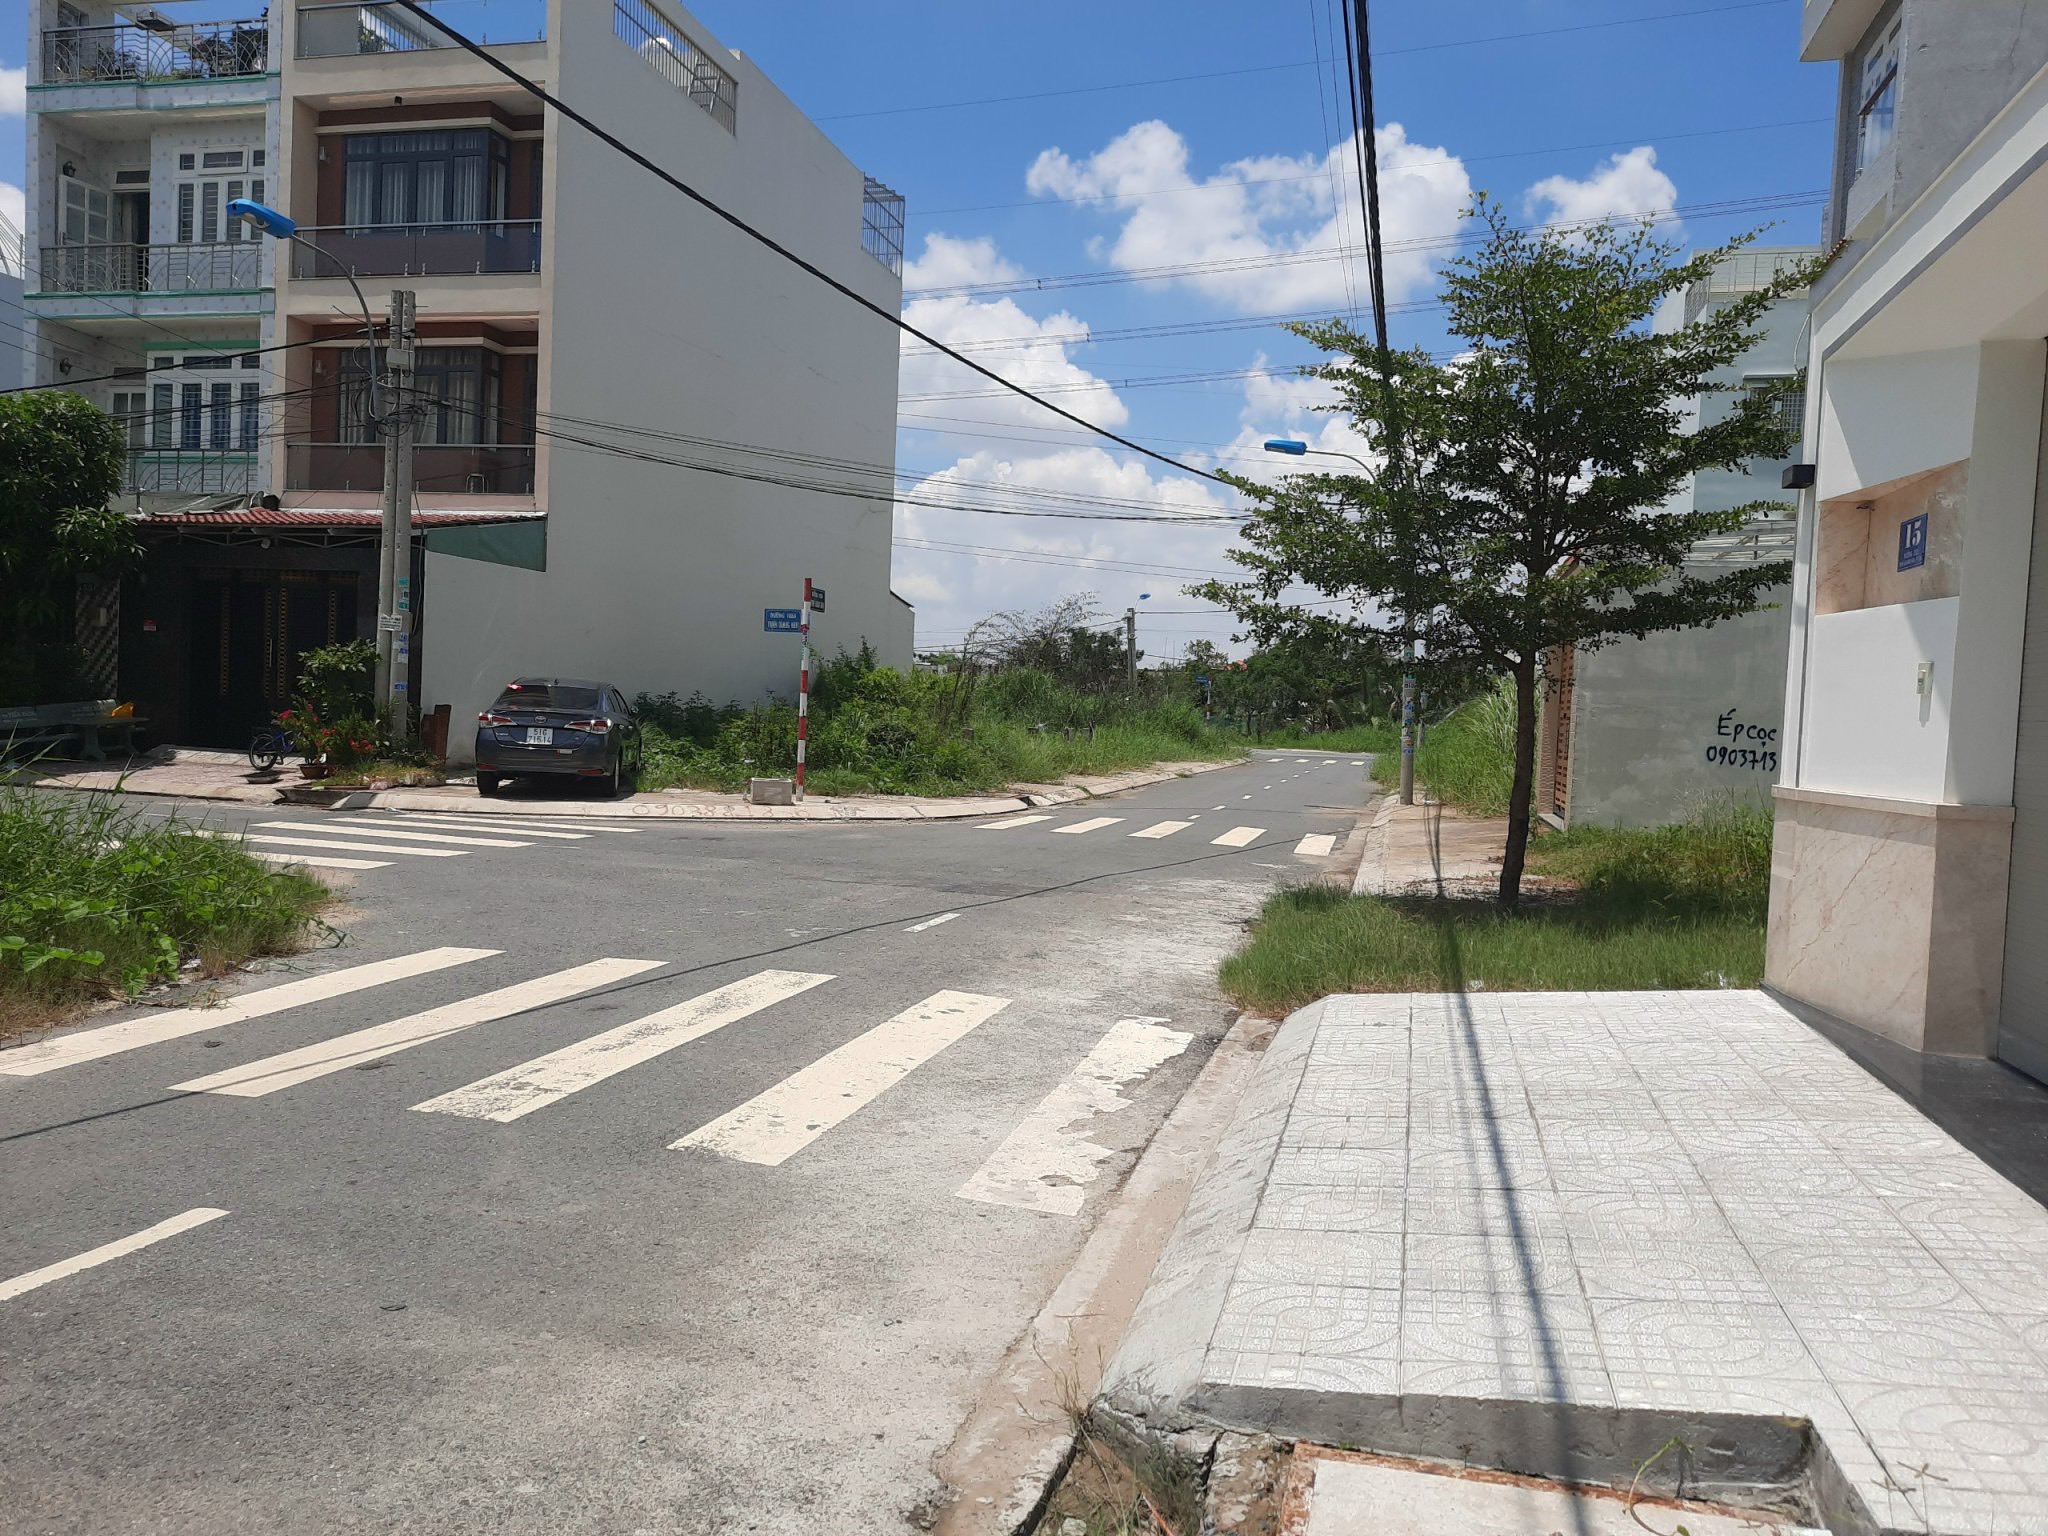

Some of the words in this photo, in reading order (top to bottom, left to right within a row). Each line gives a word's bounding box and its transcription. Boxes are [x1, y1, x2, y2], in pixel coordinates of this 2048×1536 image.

[1905, 520, 1922, 549] 15
[1717, 708, 1745, 743] Ép
[1746, 725, 1777, 748] cọc
[1706, 745, 1777, 772] 0903713
